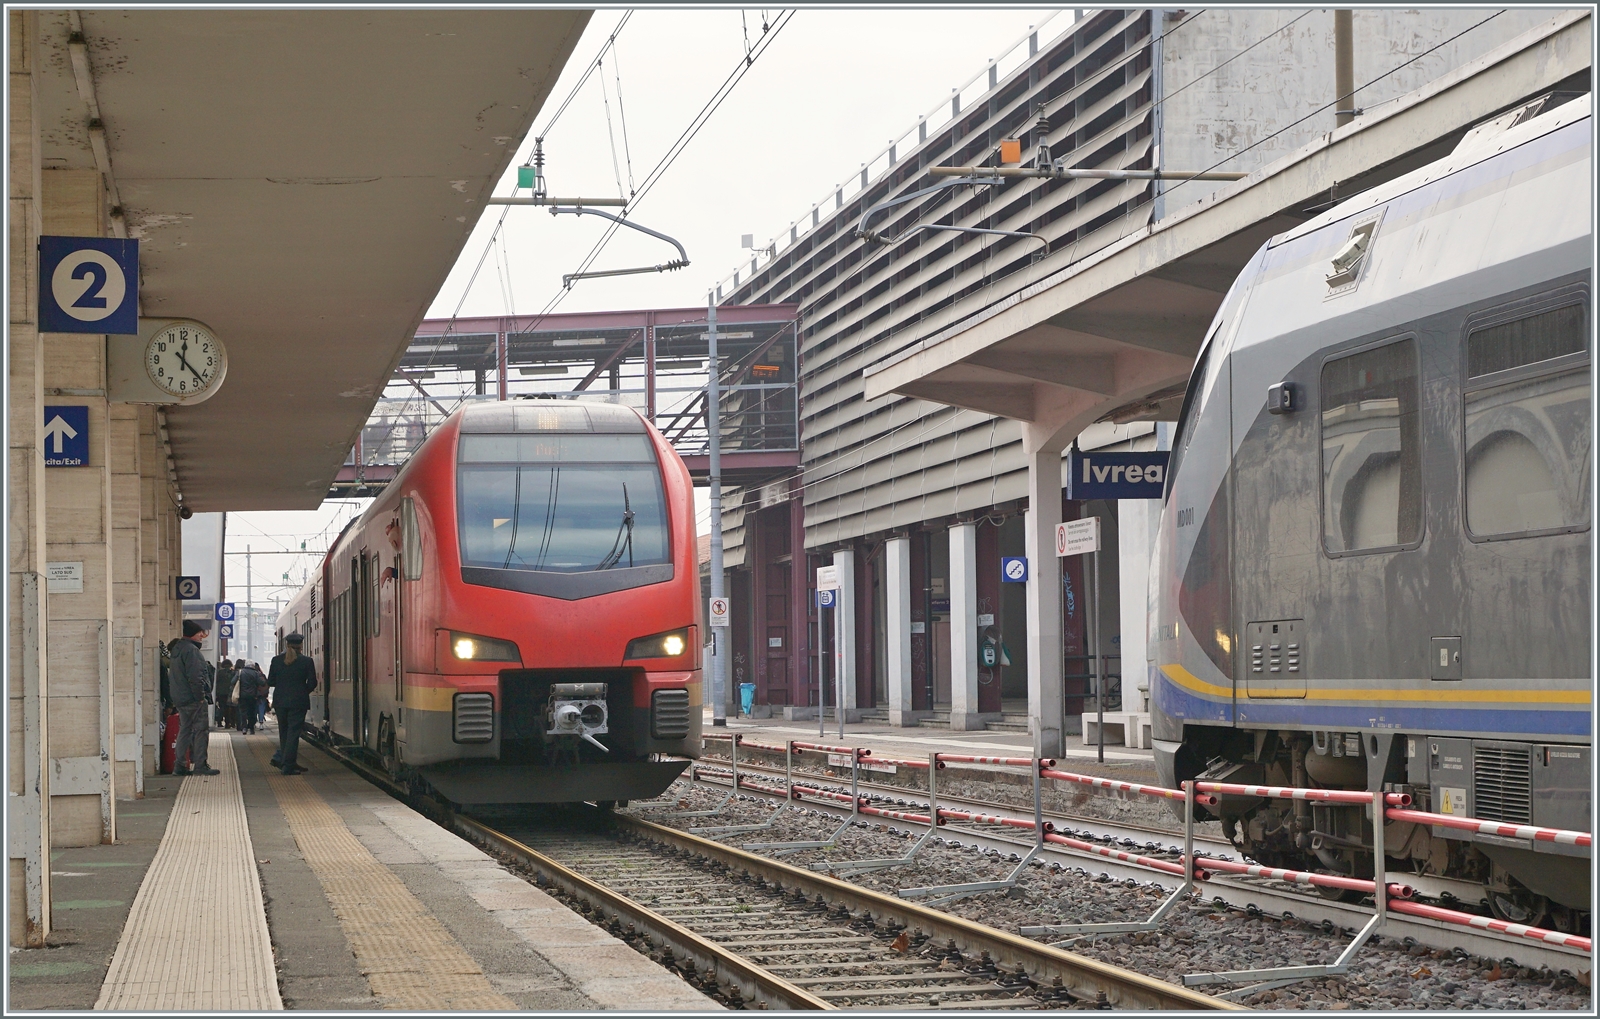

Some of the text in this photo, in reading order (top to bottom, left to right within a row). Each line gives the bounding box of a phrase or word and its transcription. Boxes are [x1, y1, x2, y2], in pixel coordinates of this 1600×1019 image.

[71, 261, 107, 309] 2
[168, 333, 175, 344] 11
[179, 330, 189, 340] 12
[194, 334, 198, 344] 1
[158, 342, 166, 352] 10
[202, 342, 208, 353] 2
[154, 354, 160, 364] 9
[206, 356, 212, 366] 3
[158, 367, 164, 378] 8
[202, 368, 208, 378] 4
[168, 376, 174, 387] 7
[180, 380, 186, 390] 6
[192, 378, 198, 388] 5
[1082, 458, 1164, 484] Ivrea
[184, 582, 193, 594] 2
